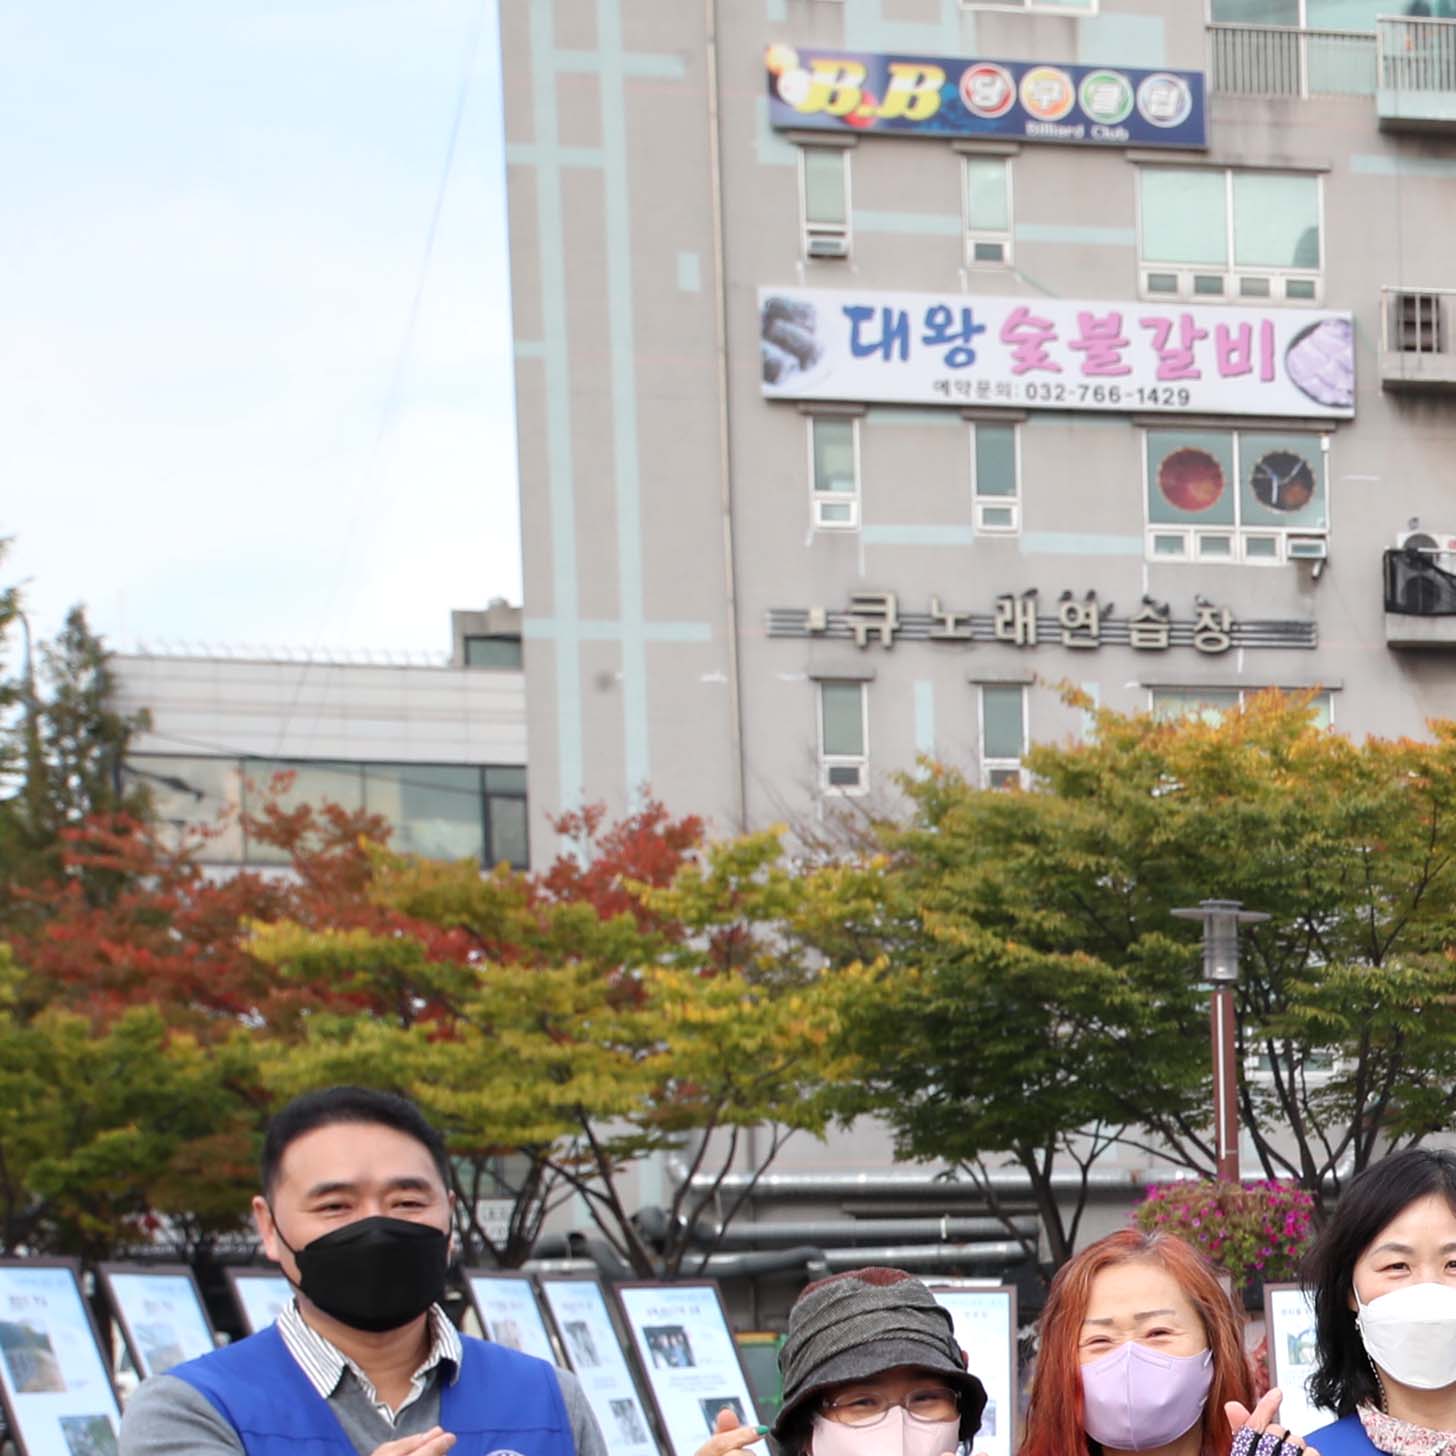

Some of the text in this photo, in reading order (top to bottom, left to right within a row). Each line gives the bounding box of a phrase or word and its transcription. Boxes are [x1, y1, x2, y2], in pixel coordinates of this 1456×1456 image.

[798, 59, 945, 120] B.B
[1090, 123, 1130, 141] Club
[841, 303, 1277, 383] 대왕 숯불갈비
[1025, 382, 1191, 407] 032-766-1429
